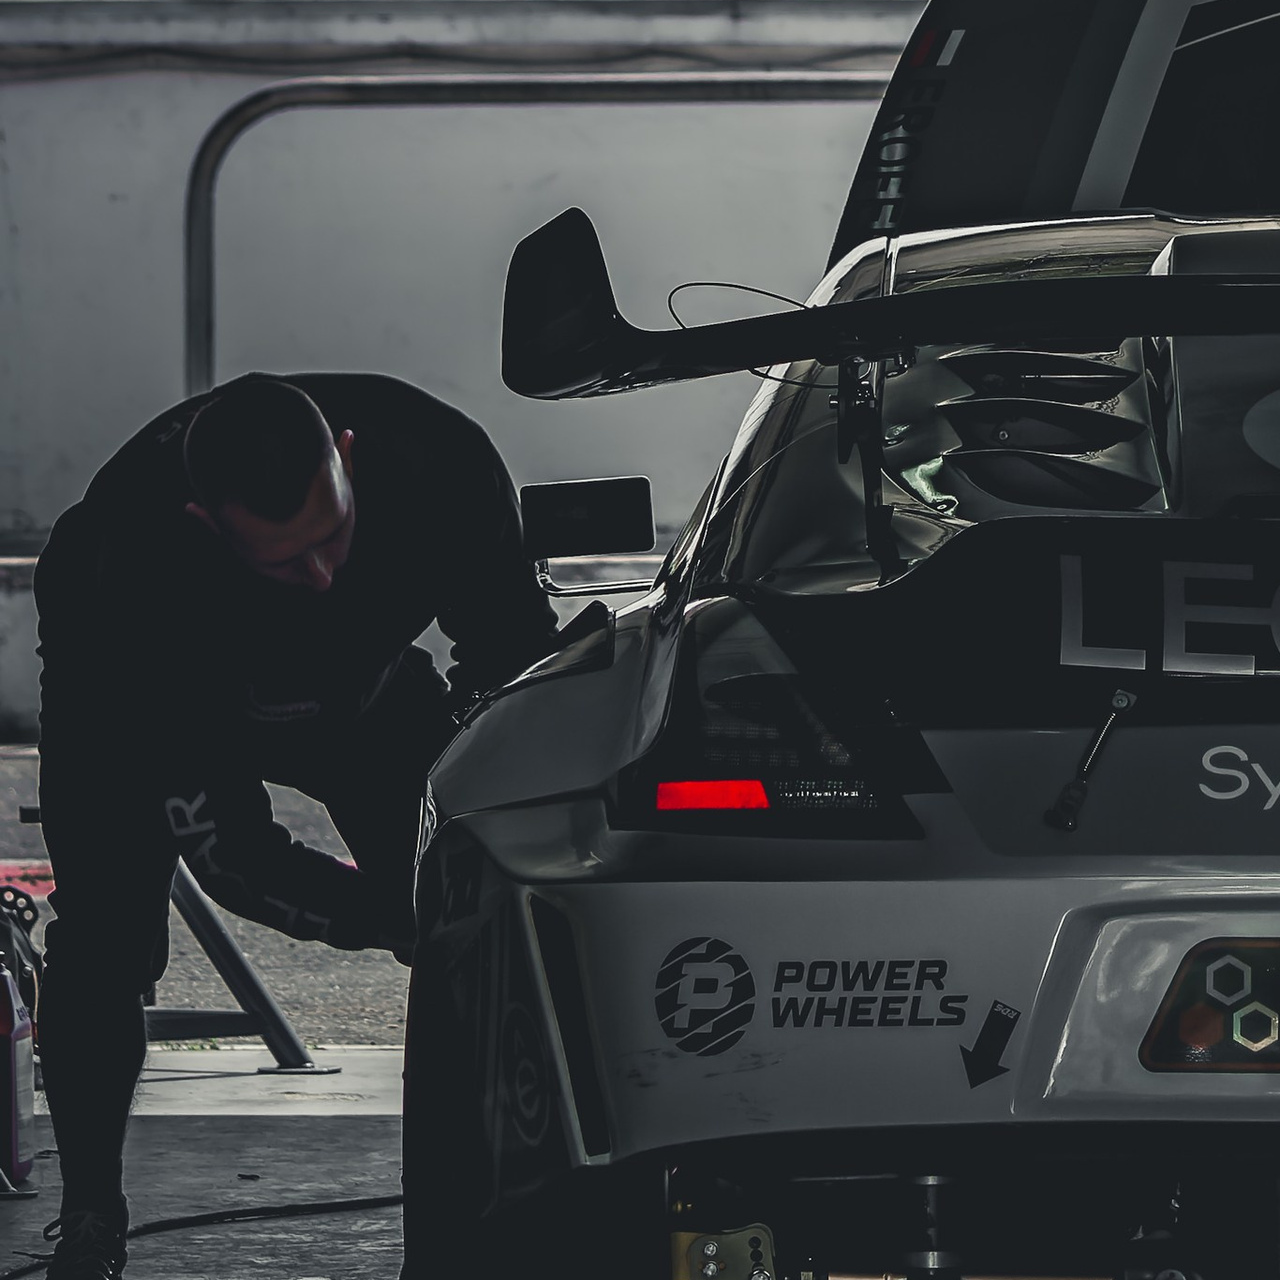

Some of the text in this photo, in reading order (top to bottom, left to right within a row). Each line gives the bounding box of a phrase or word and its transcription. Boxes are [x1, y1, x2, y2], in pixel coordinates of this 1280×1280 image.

[773, 959, 948, 992] POWER
[771, 994, 969, 1028] WHEELS
[994, 1003, 1018, 1020] RDS
